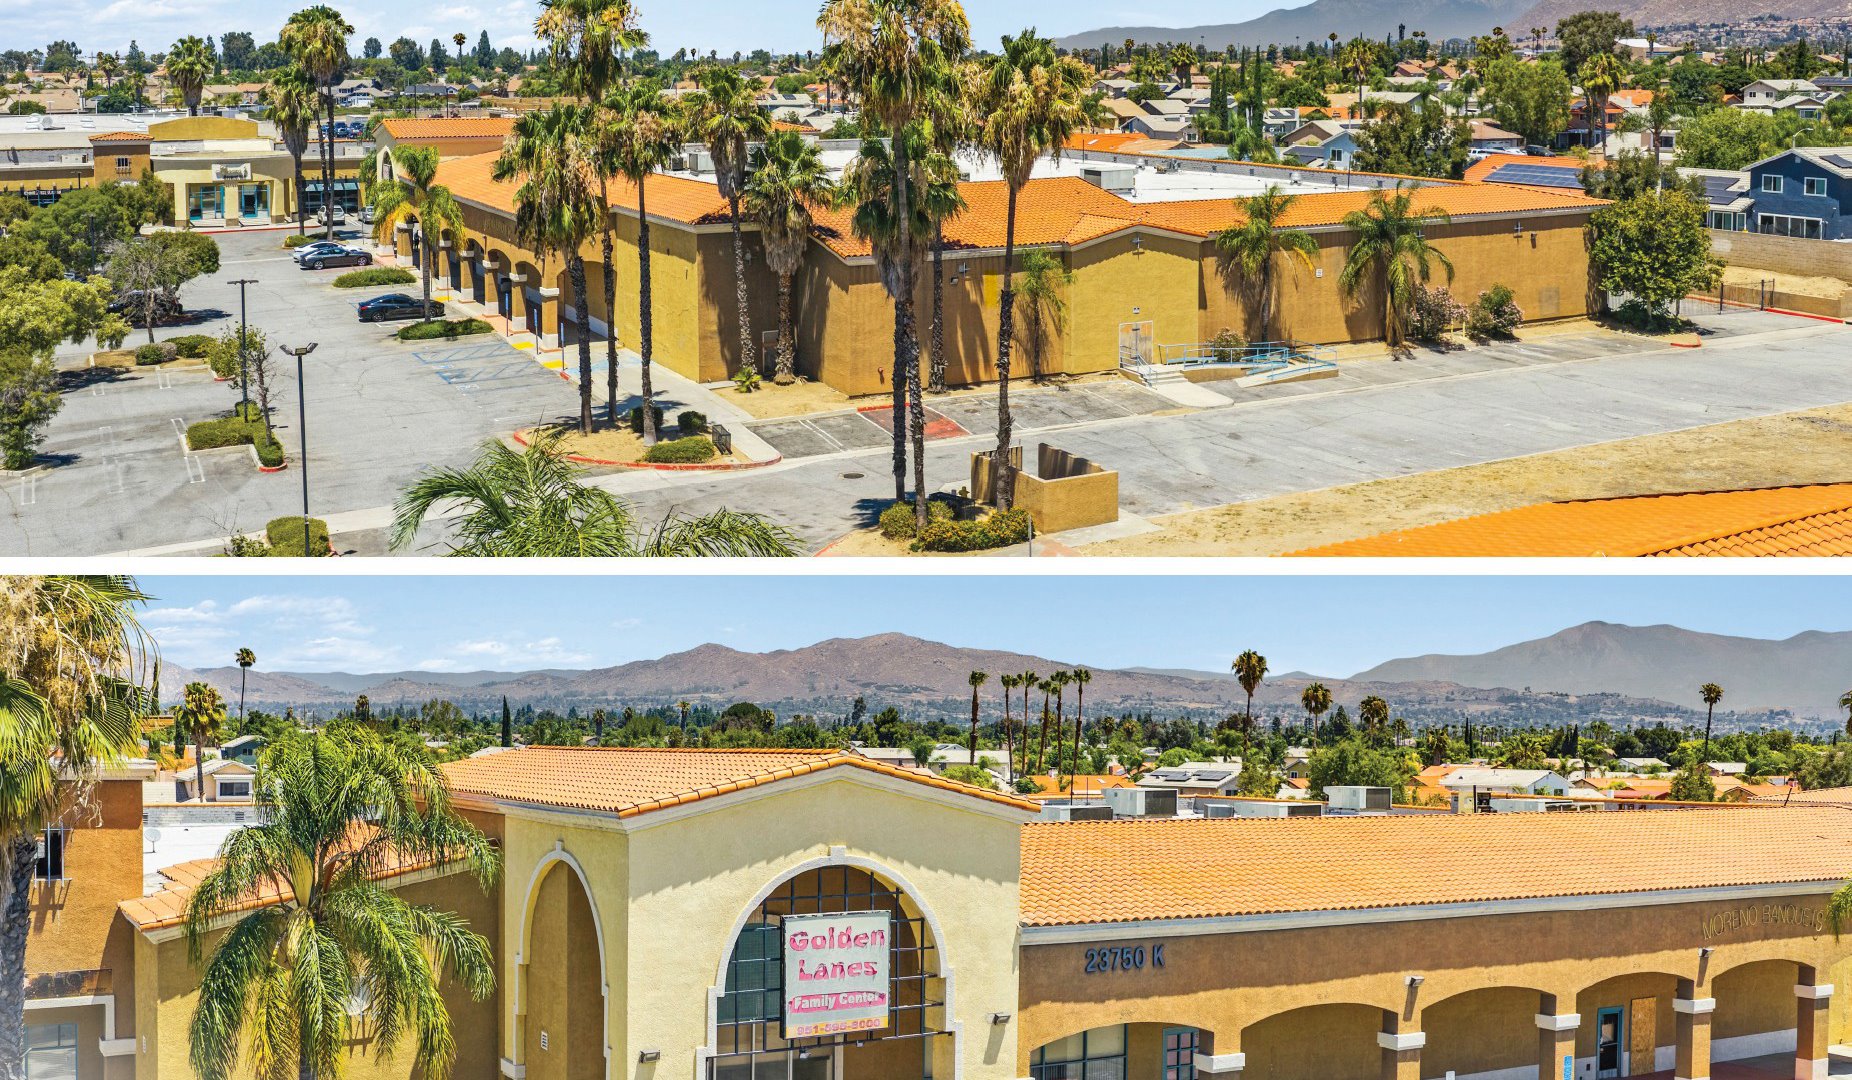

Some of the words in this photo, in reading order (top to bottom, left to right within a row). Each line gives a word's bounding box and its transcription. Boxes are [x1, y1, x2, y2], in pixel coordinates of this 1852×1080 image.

[1702, 905, 1758, 940] MORENO
[789, 925, 886, 952] Golden
[798, 959, 878, 982] Lanes
[1085, 946, 1146, 973] 23750
[1152, 943, 1165, 968] K
[794, 994, 836, 1010] Family
